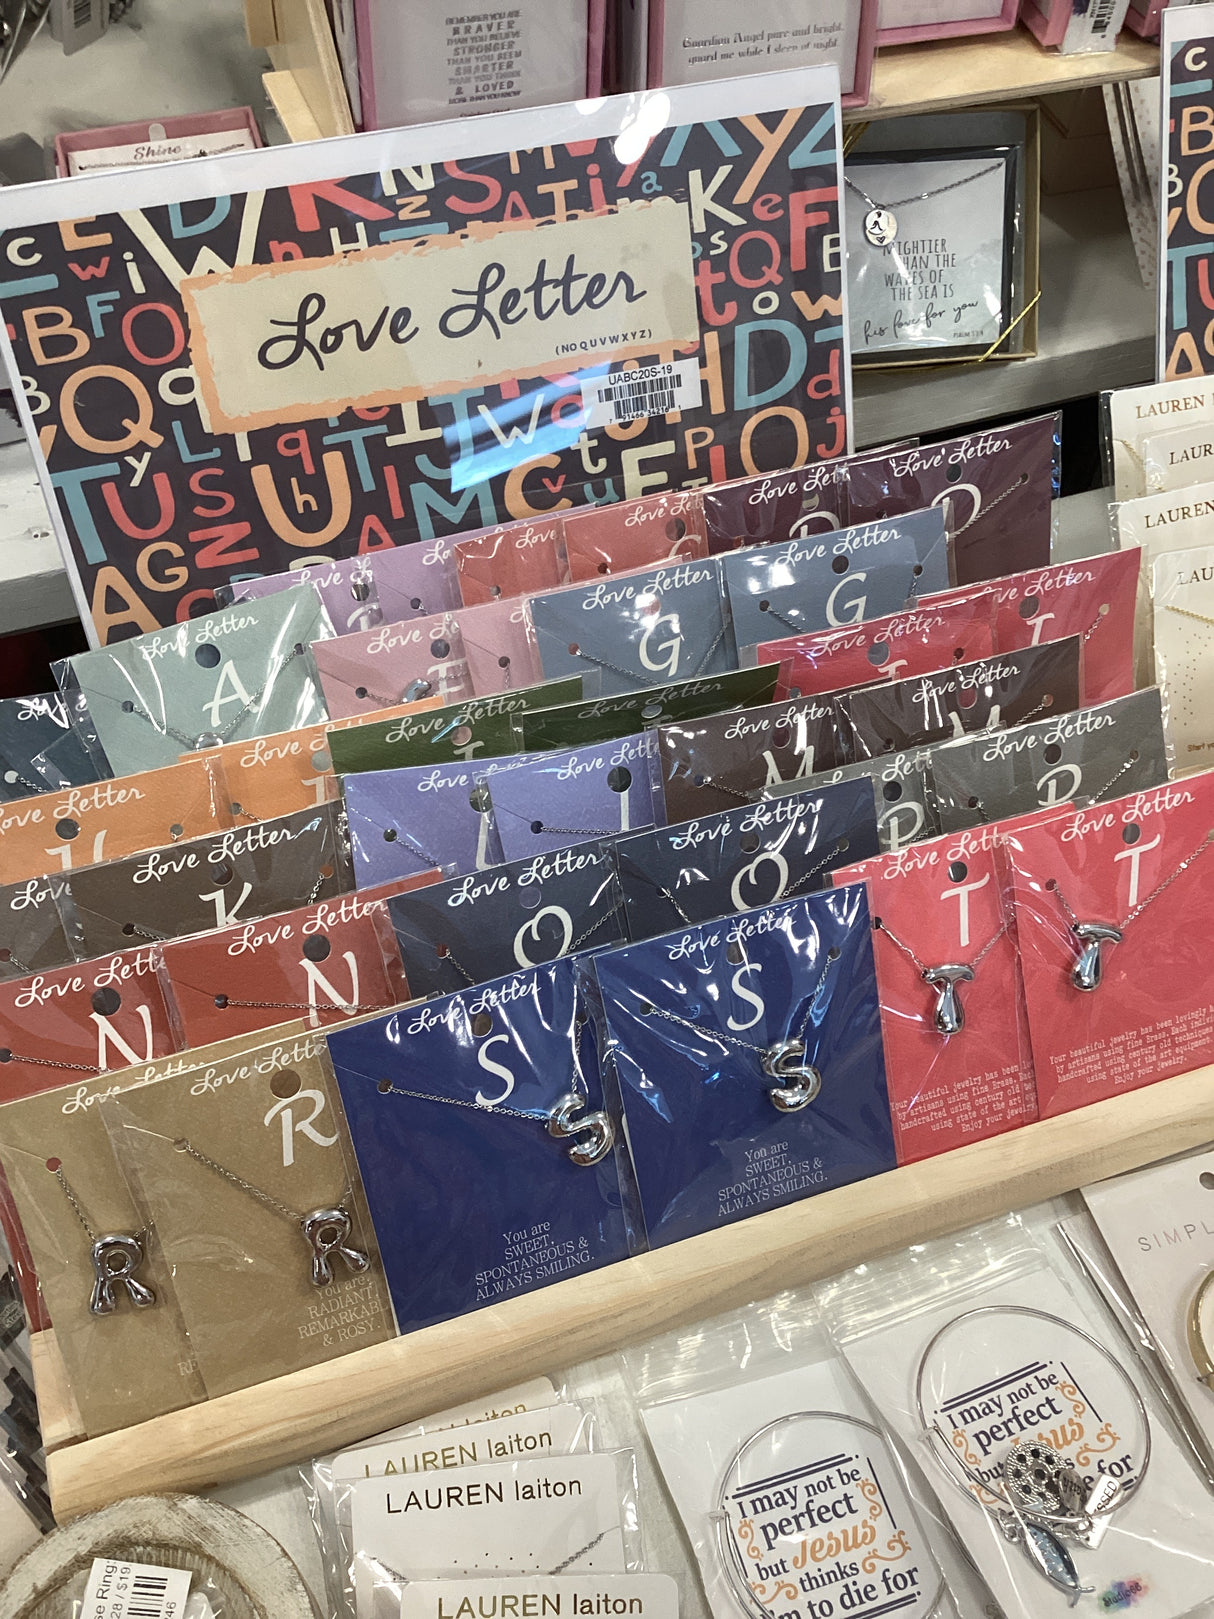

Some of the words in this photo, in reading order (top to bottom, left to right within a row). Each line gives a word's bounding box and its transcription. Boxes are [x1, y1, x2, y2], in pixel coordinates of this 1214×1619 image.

[453, 20, 515, 35] BRAVER
[454, 41, 515, 56] STRONGER
[475, 54, 493, 62] YOU
[475, 80, 513, 93] LOVED
[133, 144, 182, 161] Shine
[929, 270, 944, 283] OF
[934, 253, 956, 268] THE
[257, 292, 420, 372] Love
[437, 253, 648, 341] Letter
[890, 287, 912, 302] THE
[918, 285, 939, 300] SEA
[943, 284, 954, 298] IS
[953, 301, 978, 323] you
[608, 365, 672, 385] UABC20S-19
[1136, 394, 1205, 419] LAUREN
[894, 451, 942, 477] Love
[949, 434, 1013, 464] Letter
[749, 478, 797, 505] Love
[624, 506, 665, 527] Love
[515, 528, 557, 549] Love
[774, 540, 828, 567] Love
[832, 523, 902, 555] Letter
[582, 584, 637, 610] Love
[642, 566, 714, 596] Letter
[825, 572, 868, 628] G
[1023, 569, 1097, 597] Letter
[195, 612, 261, 643] Letter
[366, 627, 423, 654] Love
[638, 613, 681, 678] G
[872, 616, 946, 643] Letter
[202, 659, 261, 728] A
[577, 699, 639, 720] Love
[646, 681, 726, 706] Letter
[912, 677, 957, 705] Love
[962, 663, 1021, 691] Letter
[384, 718, 444, 744] Love
[454, 693, 532, 724] Letter
[724, 712, 772, 740] Love
[779, 696, 835, 728] Letter
[983, 730, 1038, 763] Love
[1043, 711, 1117, 744] Letter
[239, 740, 303, 768] Love
[557, 757, 605, 780] Love
[417, 770, 469, 792] Love
[53, 784, 146, 819] Letter
[1061, 813, 1116, 842] Love
[1122, 788, 1195, 822] Letter
[671, 816, 732, 851] Love
[741, 796, 825, 834] Letter
[132, 852, 200, 885] Love
[207, 826, 296, 864] Letter
[883, 850, 940, 880] Love
[1114, 834, 1161, 907] T
[10, 879, 73, 911] Love
[446, 873, 511, 908] Love
[518, 850, 603, 886] Letter
[227, 923, 294, 956] Love
[302, 898, 389, 935] Letter
[940, 873, 990, 947] T
[668, 930, 720, 961] Love
[726, 915, 797, 943] Letter
[14, 976, 85, 1008] Love
[298, 951, 360, 1028] N
[407, 1005, 463, 1035] Love
[469, 975, 541, 1013] Letter
[727, 963, 765, 1031] S
[88, 1004, 155, 1073] N
[1049, 1053, 1066, 1066] Your
[1069, 1040, 1106, 1057] beautiful
[1110, 1030, 1137, 1048] jewelry
[1140, 1025, 1153, 1035] has
[1156, 1019, 1173, 1031] been
[1175, 1007, 1207, 1024] lovingly
[1068, 1052, 1100, 1069] artisans
[1103, 1044, 1124, 1057] using
[1126, 1039, 1142, 1050] fine
[1146, 1031, 1169, 1045] Brass.
[1171, 1025, 1187, 1036] Each
[474, 1034, 515, 1106] S
[1058, 1063, 1102, 1083] handcrafted
[1105, 1056, 1125, 1068] using
[1129, 1045, 1156, 1060] century
[1159, 1039, 1171, 1049] old
[1086, 1071, 1107, 1084] using
[1110, 1064, 1130, 1076] state
[1145, 1055, 1157, 1065] the
[1160, 1050, 1171, 1061] art
[1114, 1073, 1134, 1085] Enjoy
[1138, 1066, 1153, 1078] your
[1157, 1056, 1187, 1072] jewelry.
[190, 1066, 251, 1096] Love
[953, 1076, 982, 1093] jewelry
[900, 1110, 947, 1131] handcrafted
[949, 1101, 971, 1115] using
[975, 1091, 1004, 1107] century
[910, 1100, 944, 1116] artisans
[947, 1091, 969, 1105] using
[263, 1088, 340, 1167] R
[931, 1118, 953, 1131] using
[745, 1147, 767, 1163] You
[771, 1141, 788, 1154] are
[718, 1160, 810, 1201] SPONTANEOUS
[813, 1157, 823, 1169] &
[718, 1188, 769, 1217] ALWAYS
[773, 1171, 828, 1197] SMILING.
[503, 1231, 527, 1245] You
[531, 1221, 551, 1236] are
[475, 1241, 575, 1286] SPONTANEOUS
[578, 1236, 589, 1249] &
[476, 1270, 533, 1301] ALWAYS
[536, 1250, 595, 1280] SMILING.
[322, 1333, 334, 1347] &
[337, 1317, 380, 1341] ROSY.
[946, 1413, 958, 1429] I
[958, 1395, 1003, 1425] may
[1007, 1382, 1037, 1405] not
[1035, 1372, 1060, 1391] be
[487, 1431, 552, 1459] laiton
[972, 1395, 1063, 1457] perfect
[386, 1482, 503, 1514] LAUREN
[515, 1477, 582, 1501] laiton
[736, 1501, 747, 1519] I
[749, 1485, 799, 1516] may
[804, 1475, 836, 1497] not
[836, 1468, 861, 1486] be
[760, 1493, 858, 1551] perfect
[754, 1558, 790, 1581] but
[792, 1519, 876, 1569] Jesus
[799, 1561, 860, 1593] thinks
[807, 1599, 834, 1619] to
[839, 1581, 878, 1610] die
[881, 1566, 919, 1596] for
[436, 1593, 560, 1619] LAUREN
[573, 1593, 643, 1615] laiton
